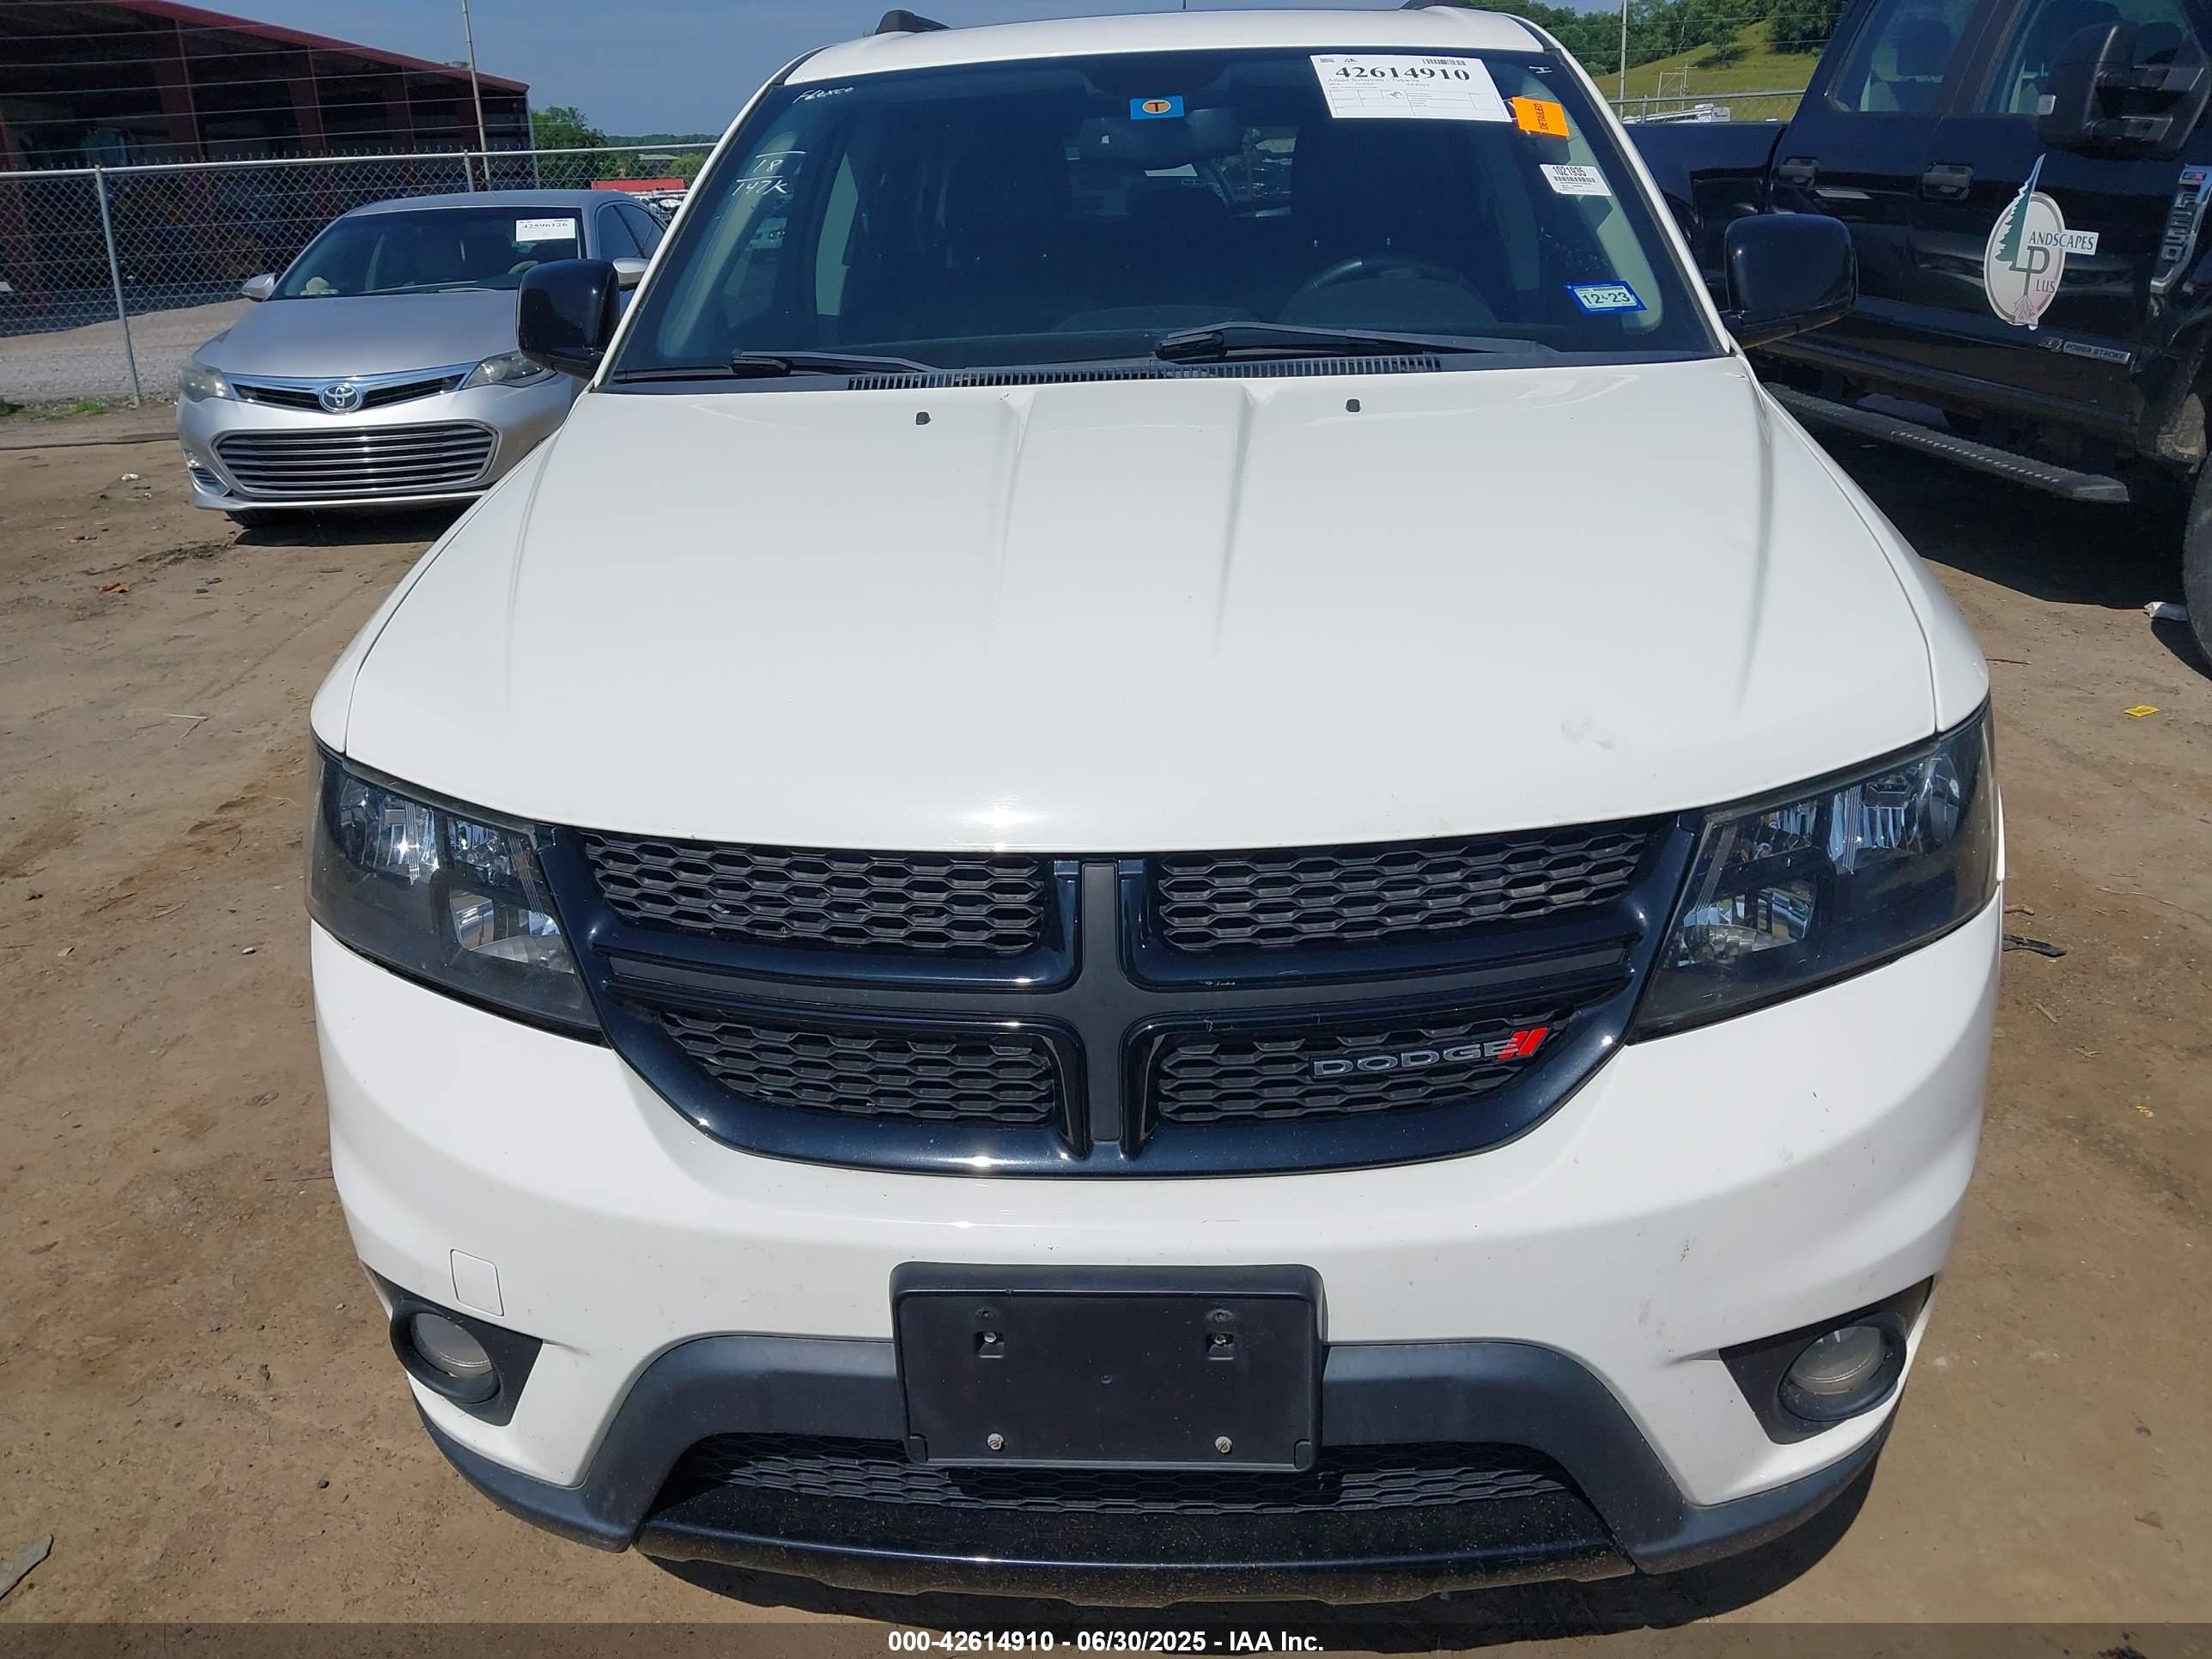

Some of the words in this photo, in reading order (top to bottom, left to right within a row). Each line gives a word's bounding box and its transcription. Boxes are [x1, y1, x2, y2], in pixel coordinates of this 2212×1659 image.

[1335, 65, 1470, 81] 42614910
[1147, 101, 1166, 112] T
[1534, 103, 1549, 130] DETAILED
[1553, 166, 1587, 177] 1021935
[2029, 231, 2094, 250] ANDSCAPES
[2036, 279, 2056, 293] LUS
[1314, 1038, 1519, 1076] DODGE
